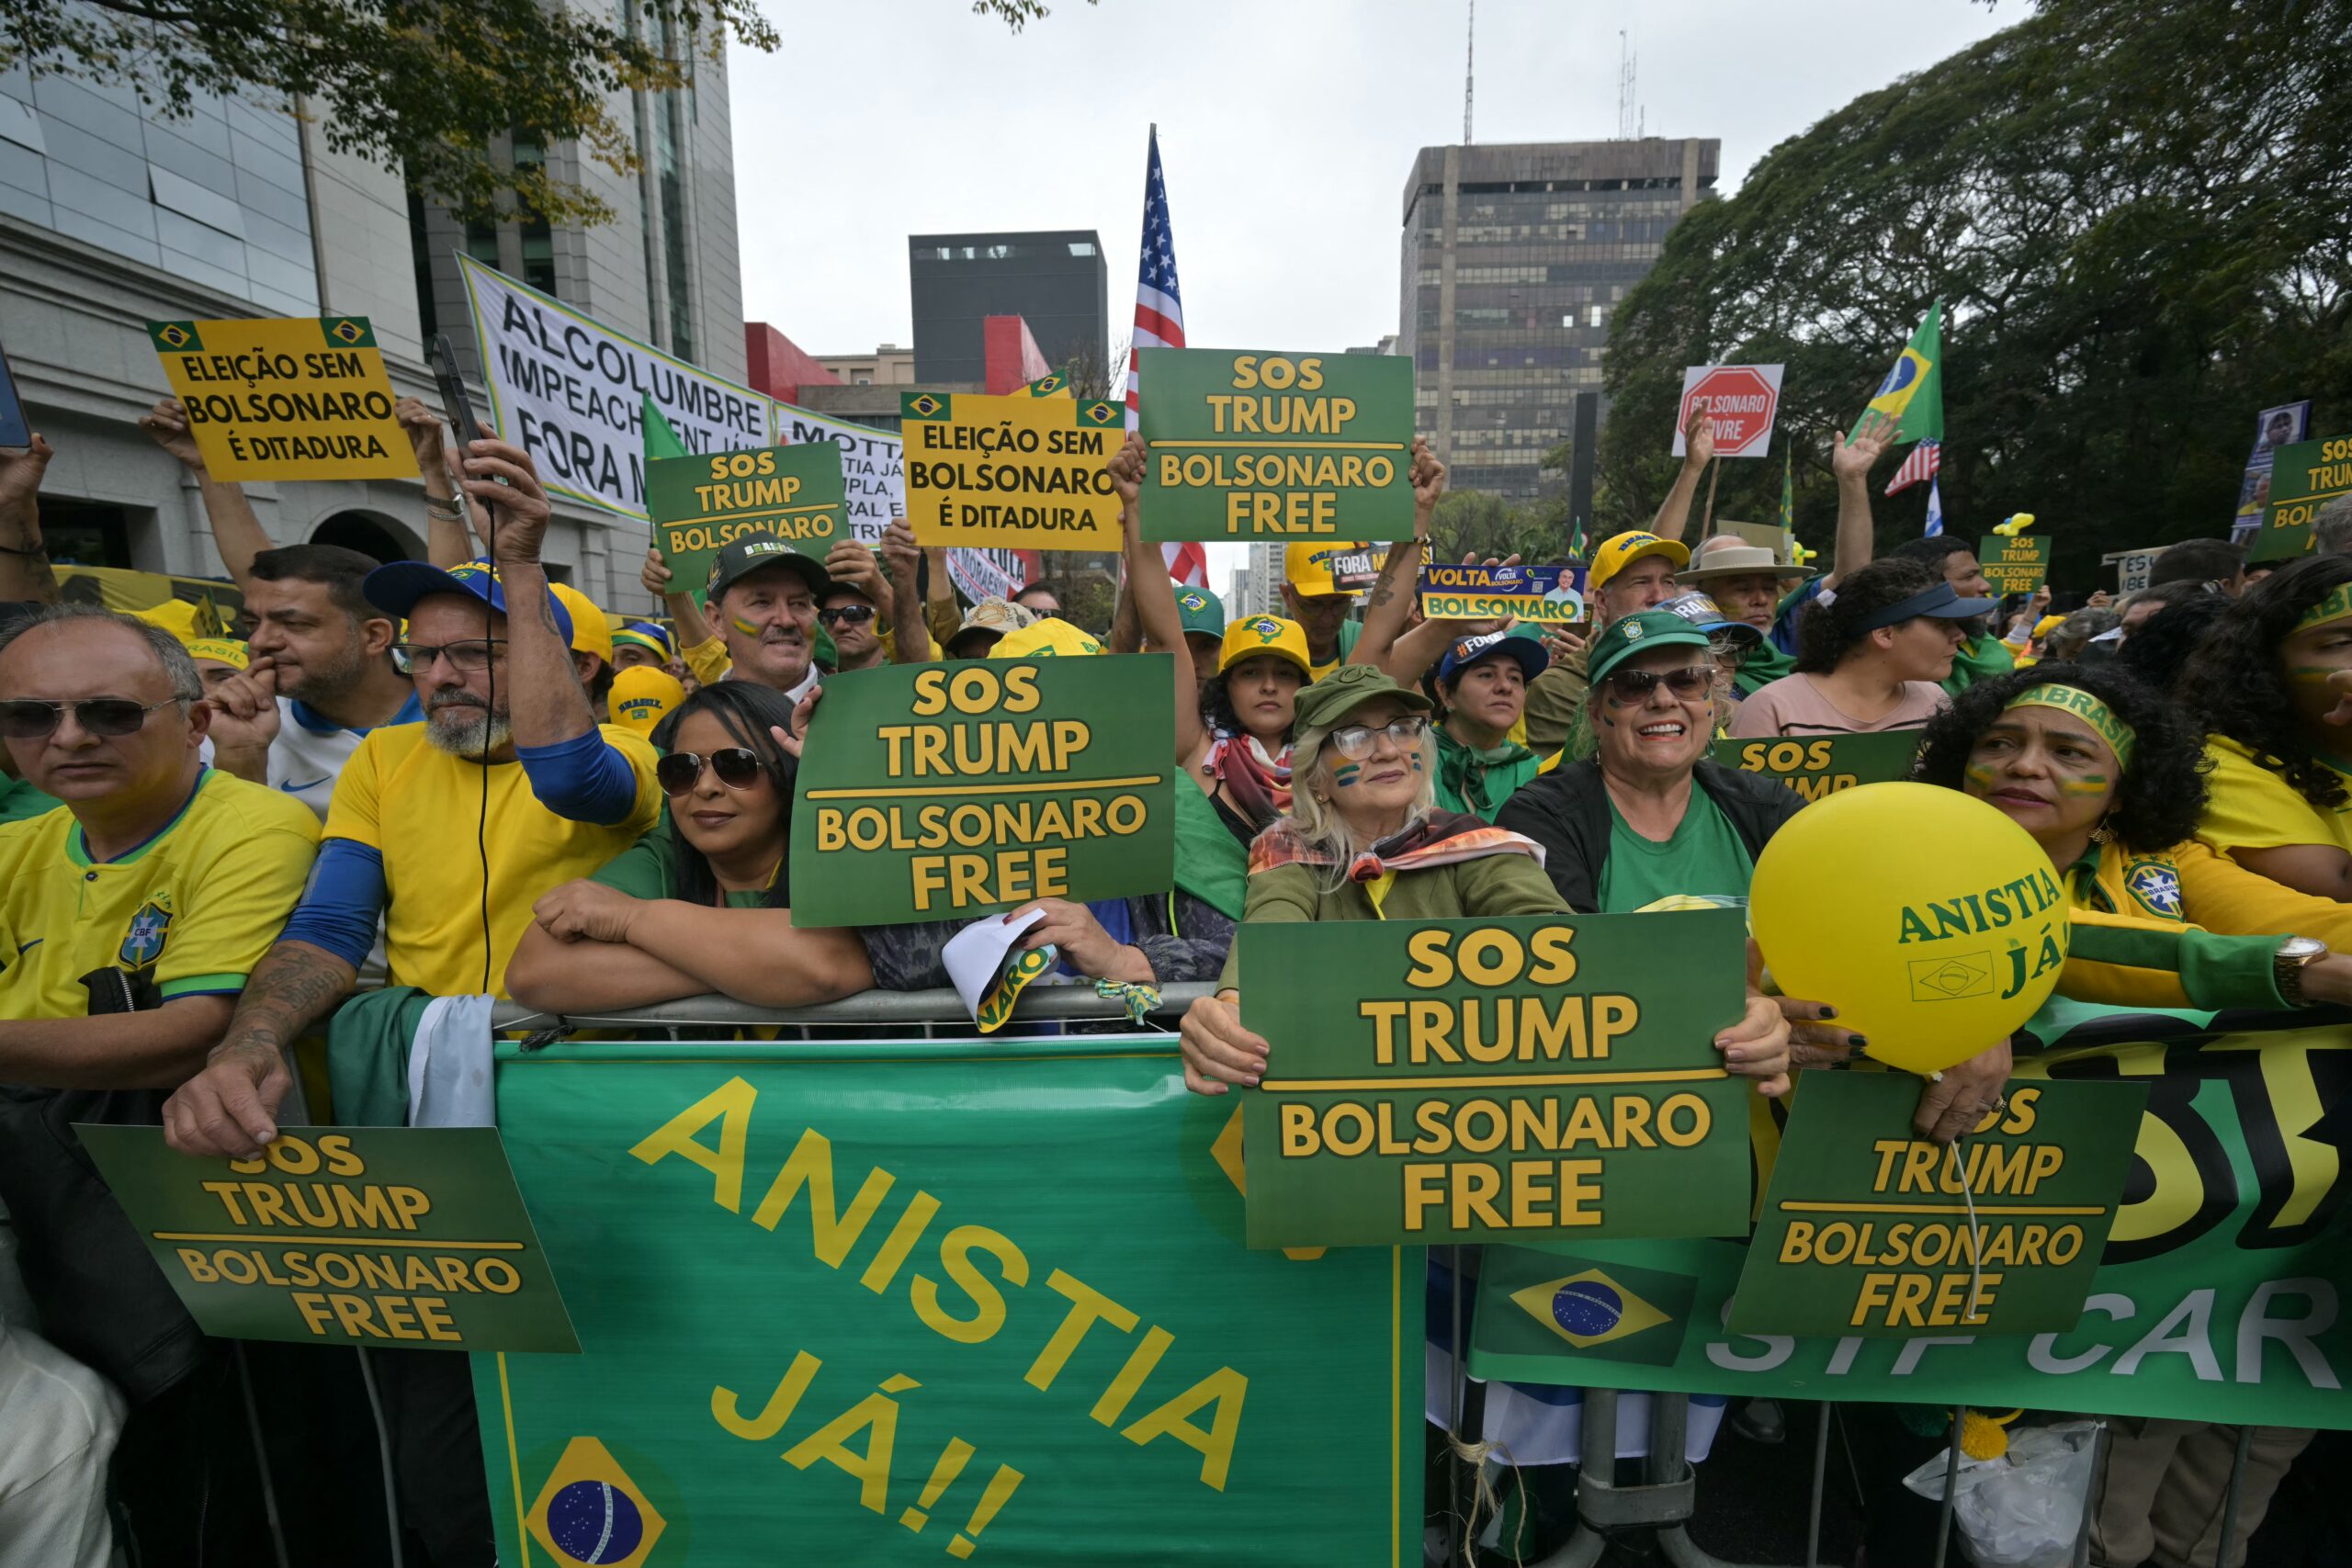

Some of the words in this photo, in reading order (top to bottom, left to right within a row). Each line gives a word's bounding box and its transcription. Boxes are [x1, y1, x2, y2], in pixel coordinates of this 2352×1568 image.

[182, 347, 299, 389] ELEIÇÃO
[304, 352, 366, 379] SEM
[503, 292, 763, 437] ALCOLUMBRE
[1232, 355, 1324, 390] SOS
[184, 390, 393, 424] BOLSONARO
[1205, 395, 1356, 434] TRUMP
[228, 431, 250, 462] É
[249, 434, 390, 460] DITADURA
[516, 406, 623, 499] FORA
[793, 420, 905, 459] MOTT
[922, 420, 1039, 457] ELEIÇÃO
[1046, 430, 1103, 456] SEM
[710, 451, 775, 480] SOS
[880, 460, 904, 477] JÁ
[910, 462, 1116, 496] BOLSONARO
[1159, 454, 1395, 488] BOLSONARO
[695, 477, 801, 513] TRUMP
[939, 497, 954, 526] É
[962, 505, 1098, 532] DITADURA
[1227, 491, 1337, 534] FREE
[2001, 550, 2041, 562] TRUMP
[2010, 537, 2034, 548] SOS
[1334, 555, 1371, 576] FORA
[1428, 569, 1490, 587] VOLTA
[1498, 572, 1517, 581] VOLTA
[1984, 567, 2044, 578] BOLSONARO
[2003, 579, 2032, 592] FREE
[1428, 597, 1578, 619] BOLSONARO
[912, 665, 1041, 716] SOS
[876, 720, 1091, 777] TRUMP
[1738, 739, 1834, 773] SOS
[818, 794, 1148, 852] BOLSONARO
[911, 846, 1069, 910] FREE
[2147, 883, 2179, 897] BRASIL
[1898, 866, 2062, 944] ANISTIA
[134, 928, 152, 937] CBF
[1406, 926, 1577, 987] SOS
[1360, 995, 1640, 1066] TRUMP
[1280, 1092, 1712, 1157] BOLSONARO
[1873, 1140, 2064, 1195] TRUMP
[201, 1181, 431, 1230] TRUMP
[1402, 1158, 1603, 1231] FREE
[1779, 1221, 2084, 1267] BOLSONARO
[176, 1247, 522, 1294] BOLSONARO
[628, 1075, 1250, 1493] ANISTIA
[291, 1292, 463, 1342] FREE
[1849, 1272, 2003, 1328] FREE
[711, 1349, 1025, 1561] JÁ!!
